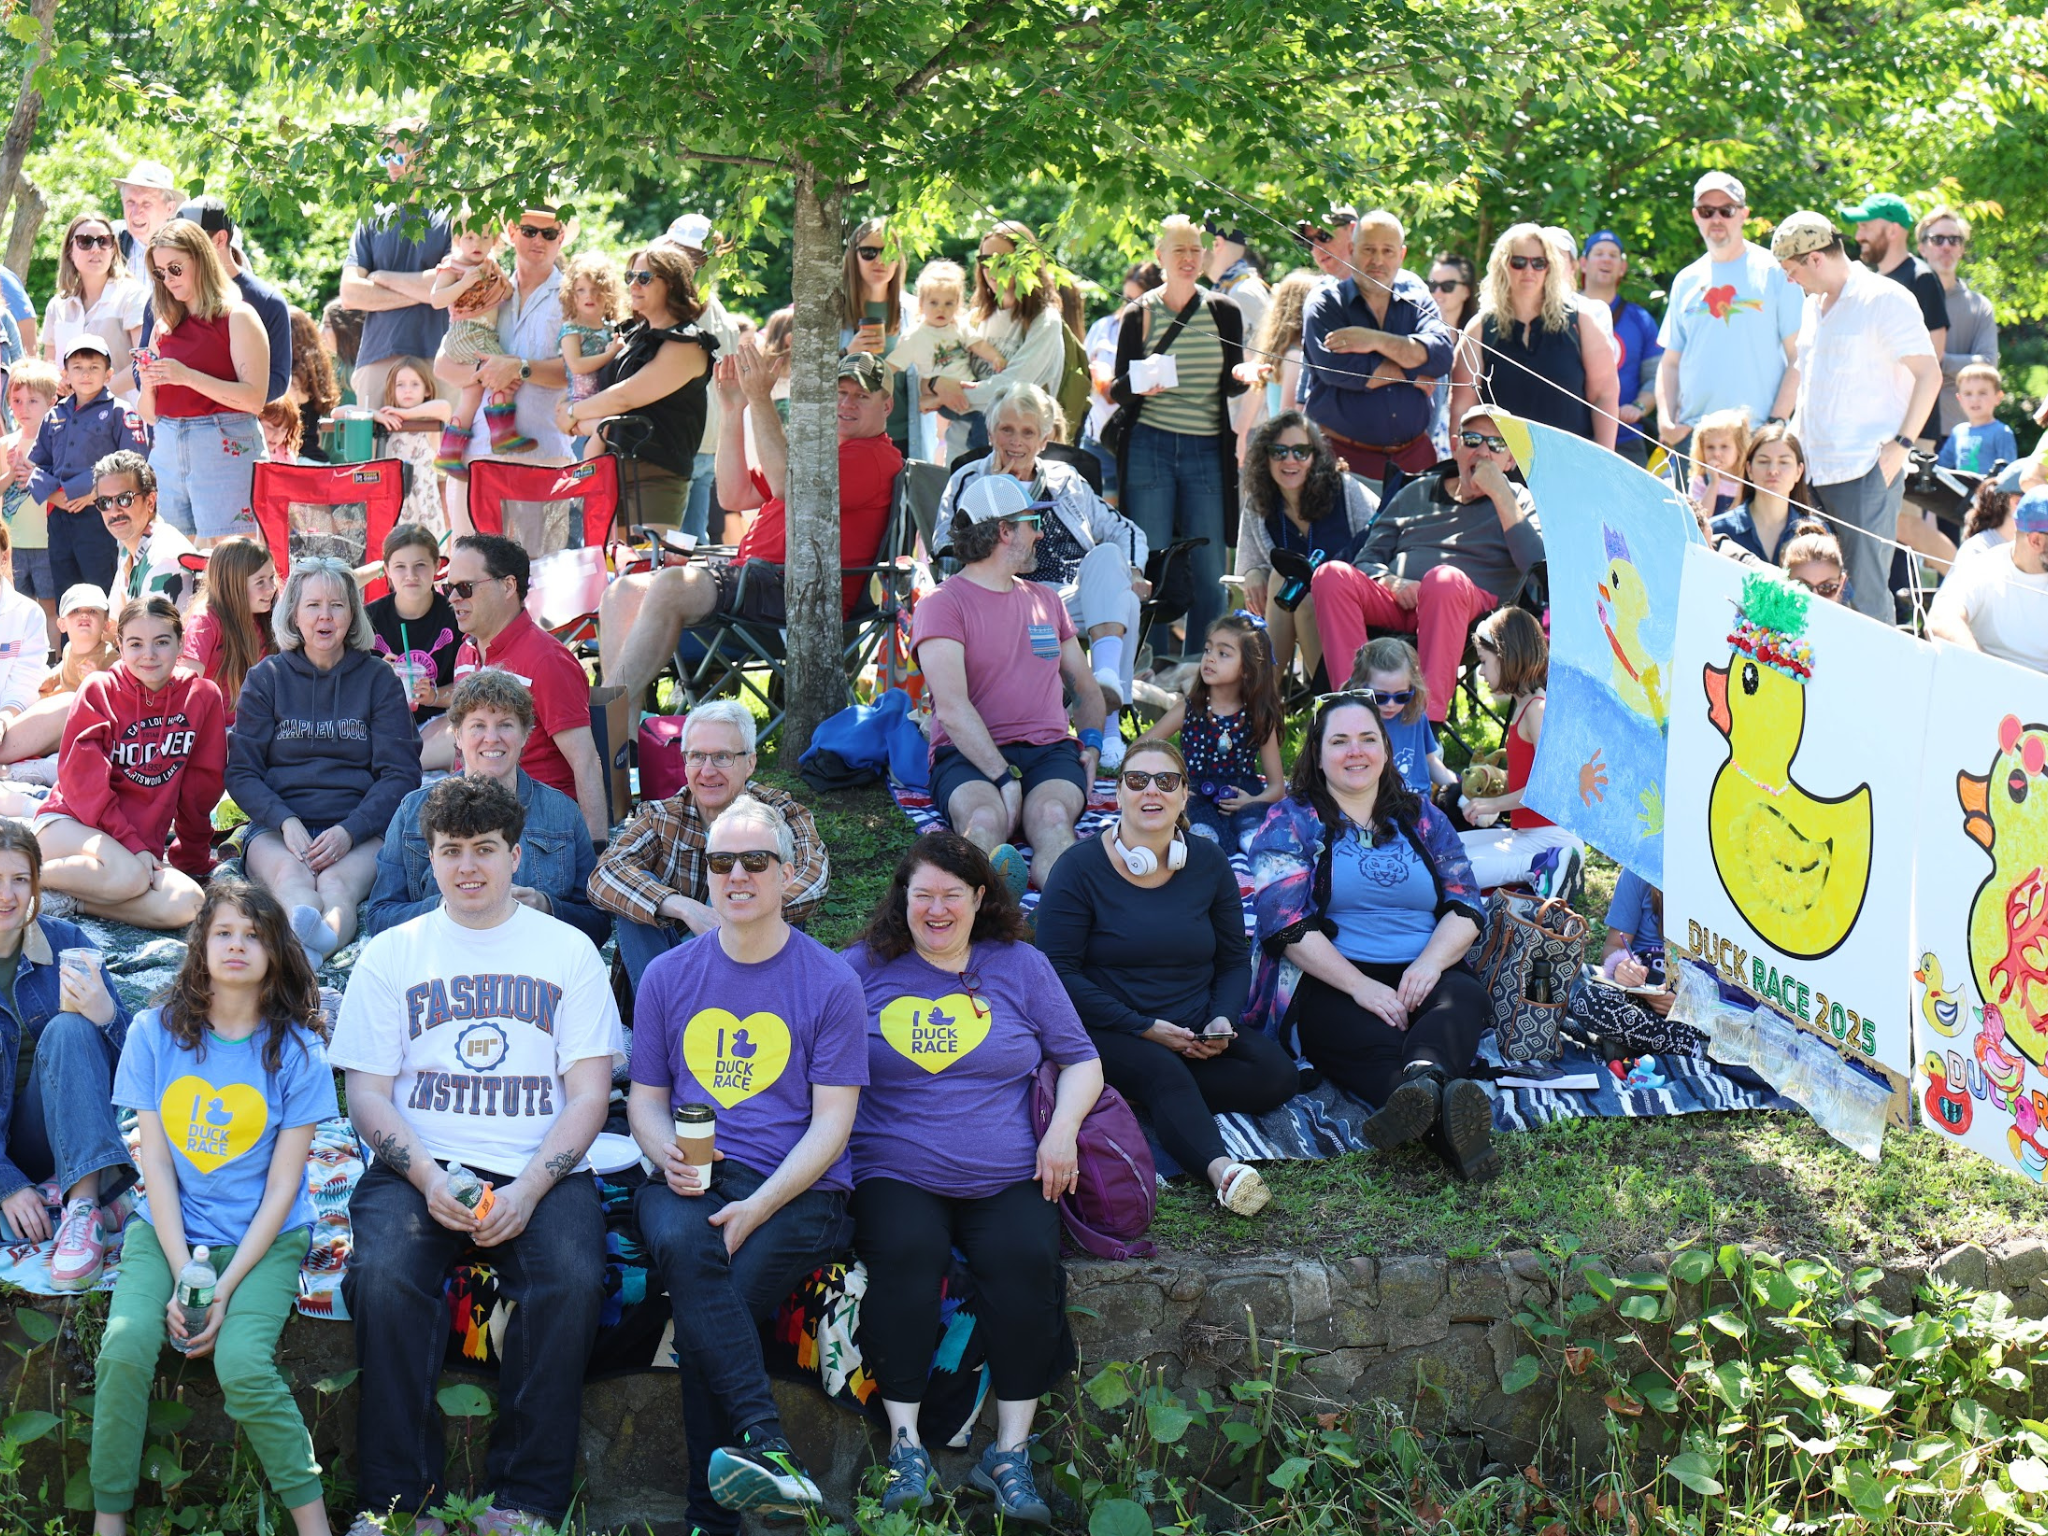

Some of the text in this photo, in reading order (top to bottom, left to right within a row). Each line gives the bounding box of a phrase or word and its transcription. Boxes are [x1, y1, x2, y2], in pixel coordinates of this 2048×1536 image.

[163, 763, 179, 781] LAKE
[1688, 918, 1877, 1057] DUCK RACE 2025
[405, 973, 562, 1041] FASHION
[912, 1010, 920, 1027] I
[716, 1028, 725, 1058] I
[911, 1027, 958, 1040] DUCK
[911, 1040, 958, 1054] RACE
[715, 1060, 755, 1077] DUCK
[713, 1074, 752, 1092] RACE
[1947, 1049, 2025, 1112] DUC
[407, 1071, 554, 1117] INSTITUTE
[190, 1094, 201, 1122] I
[188, 1123, 231, 1142] DUCK
[186, 1137, 229, 1156] RACE
